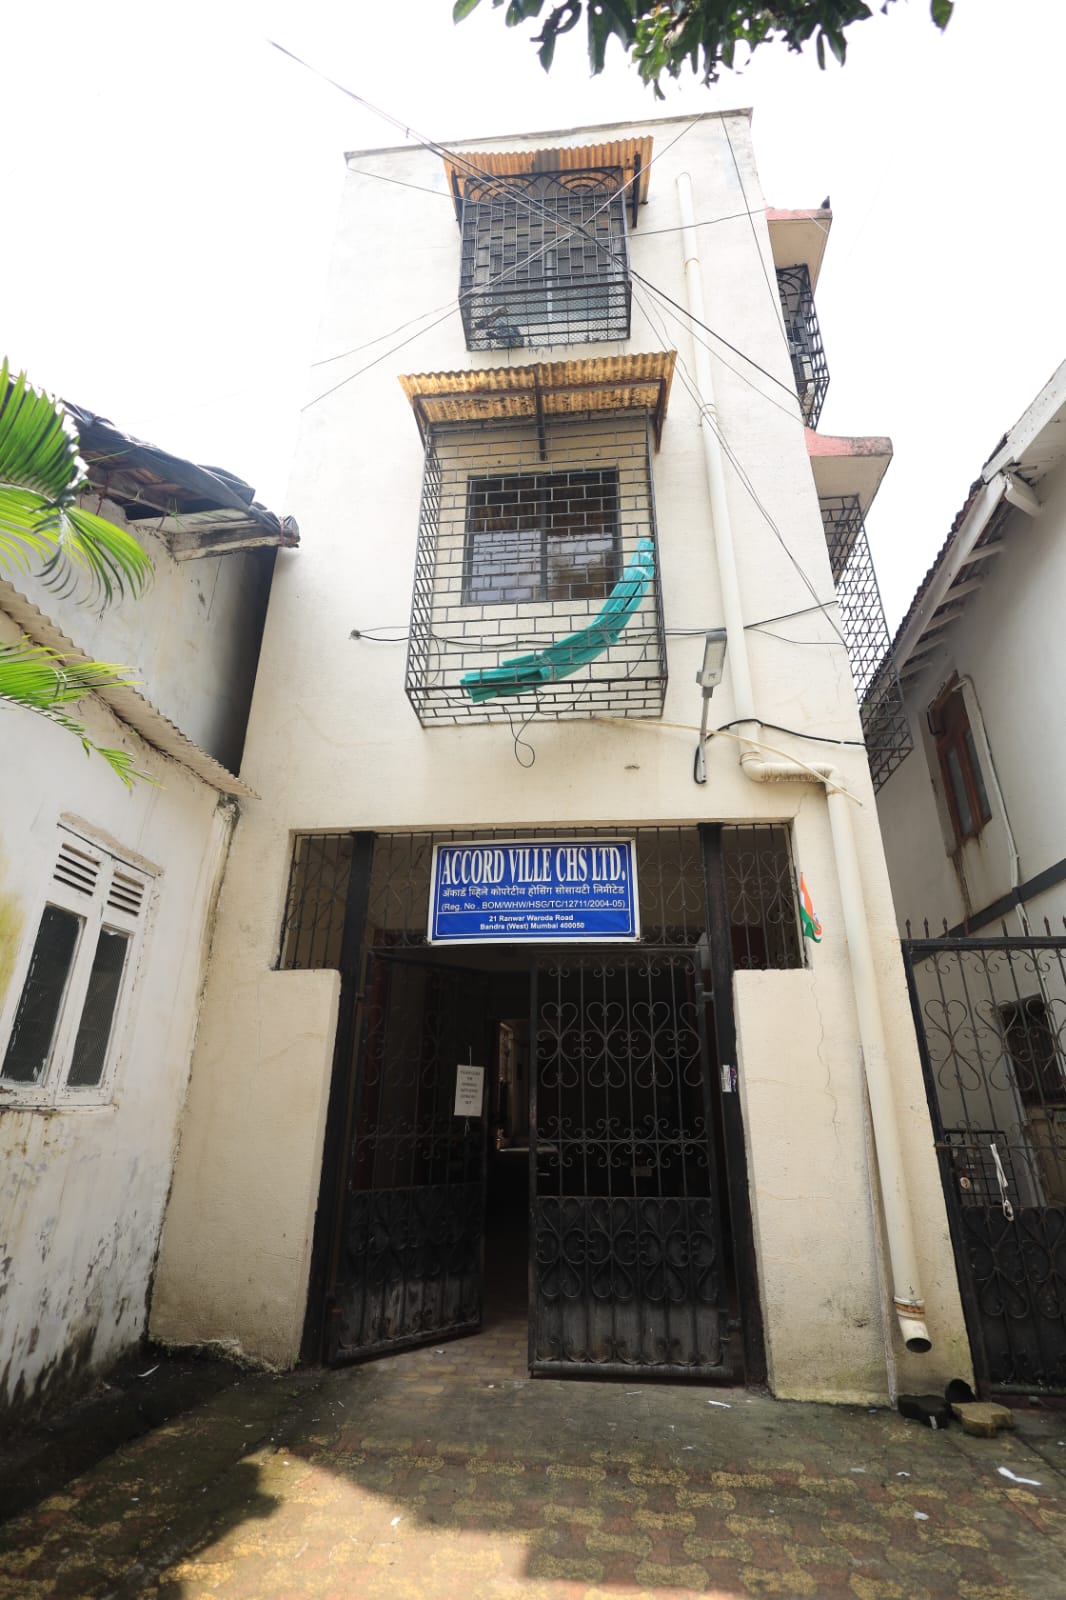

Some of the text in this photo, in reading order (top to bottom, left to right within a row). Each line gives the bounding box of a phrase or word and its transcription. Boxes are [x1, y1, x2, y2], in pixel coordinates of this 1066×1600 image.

[441, 846, 626, 885] ACCORD VILLE CHS LTD.
[555, 884, 590, 895] सोसायटी
[507, 923, 529, 931] (West)
